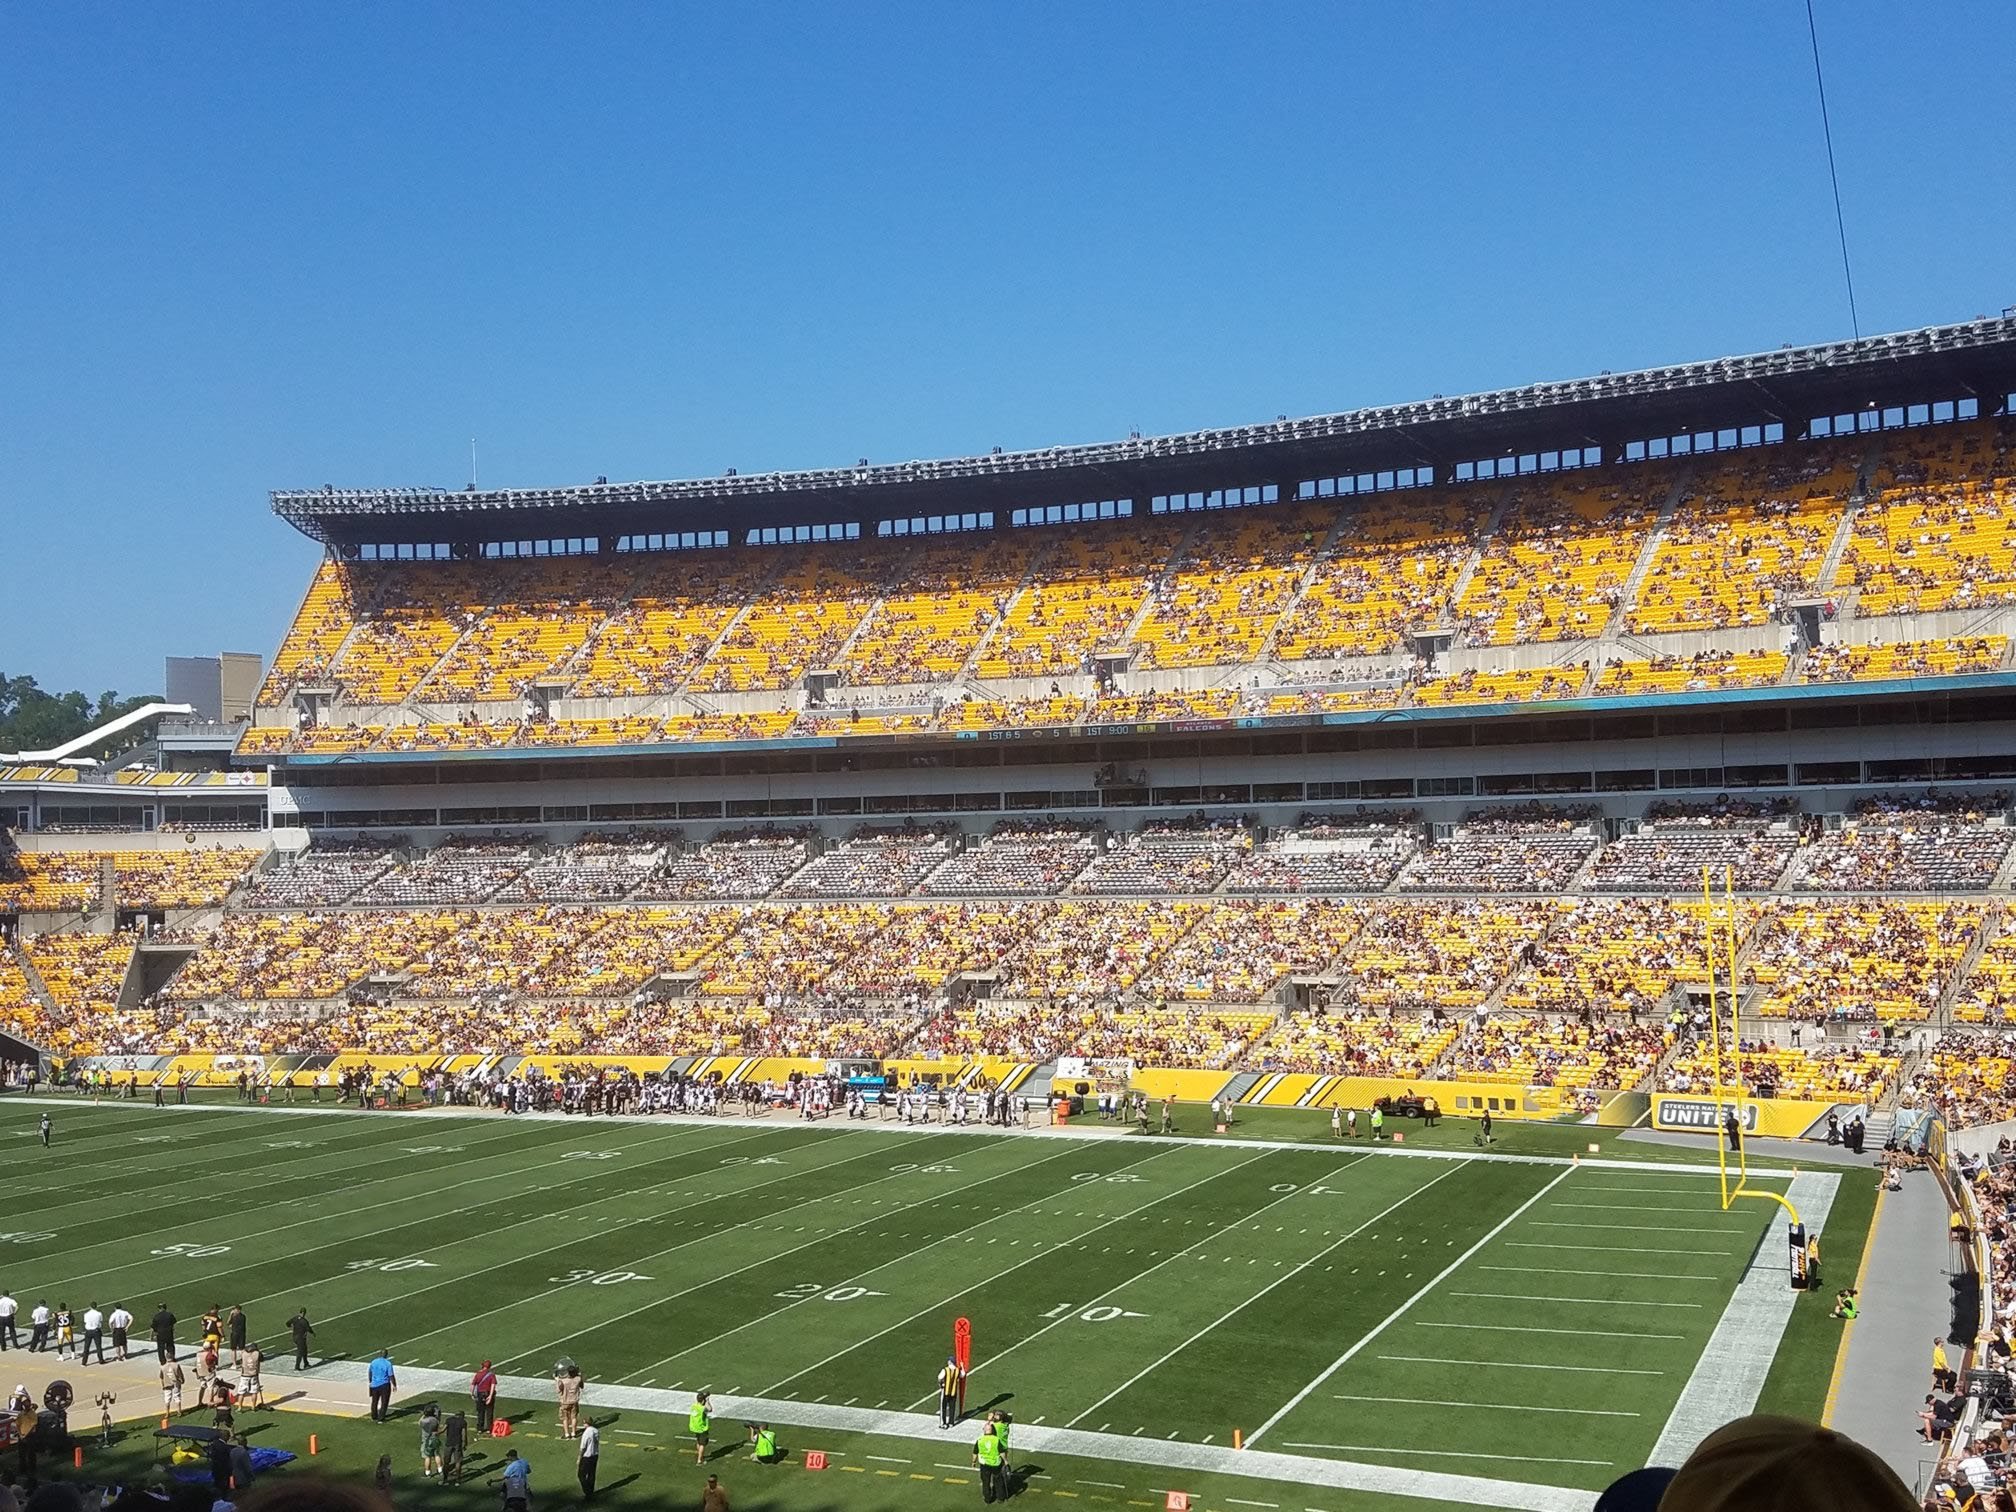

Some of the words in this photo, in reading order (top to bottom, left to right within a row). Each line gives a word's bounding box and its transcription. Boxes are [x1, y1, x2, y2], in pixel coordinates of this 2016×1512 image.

[1087, 727, 1102, 736] 1ST
[1109, 726, 1129, 735] 9:00
[1176, 724, 1222, 732] FALCONS
[988, 731, 1003, 741] 1ST
[1664, 1103, 1700, 1111] STEELERS
[150, 1243, 231, 1257] 50
[548, 1269, 636, 1285] 30
[773, 1284, 867, 1301] 20
[1037, 1303, 1123, 1321] 10
[57, 1315, 70, 1326] 35
[206, 1319, 213, 1331] 7
[494, 1422, 505, 1434] 20
[809, 1454, 822, 1467] 10
